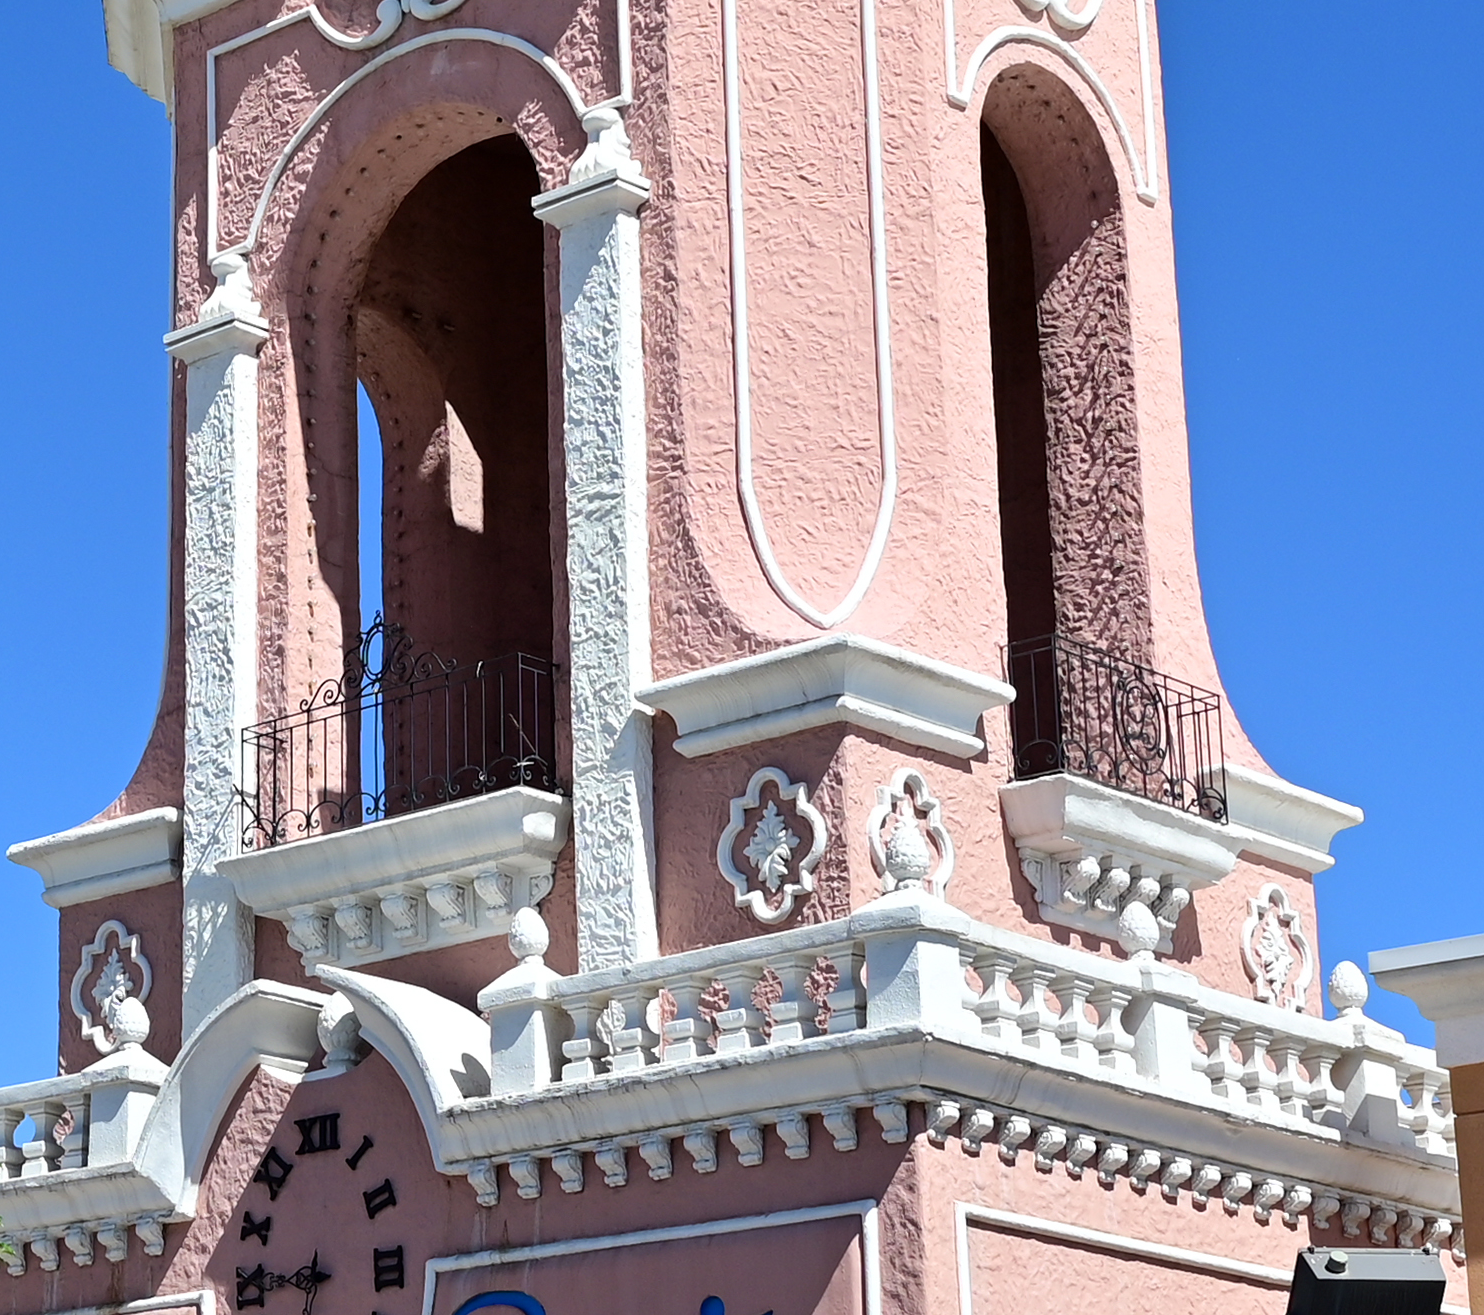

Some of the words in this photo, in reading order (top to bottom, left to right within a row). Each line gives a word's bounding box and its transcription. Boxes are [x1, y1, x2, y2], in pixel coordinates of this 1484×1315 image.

[294, 1112, 340, 1155] XII
[253, 1145, 294, 1202] XI
[362, 1177, 397, 1220] II
[240, 1210, 271, 1247] X
[373, 1244, 405, 1293] III
